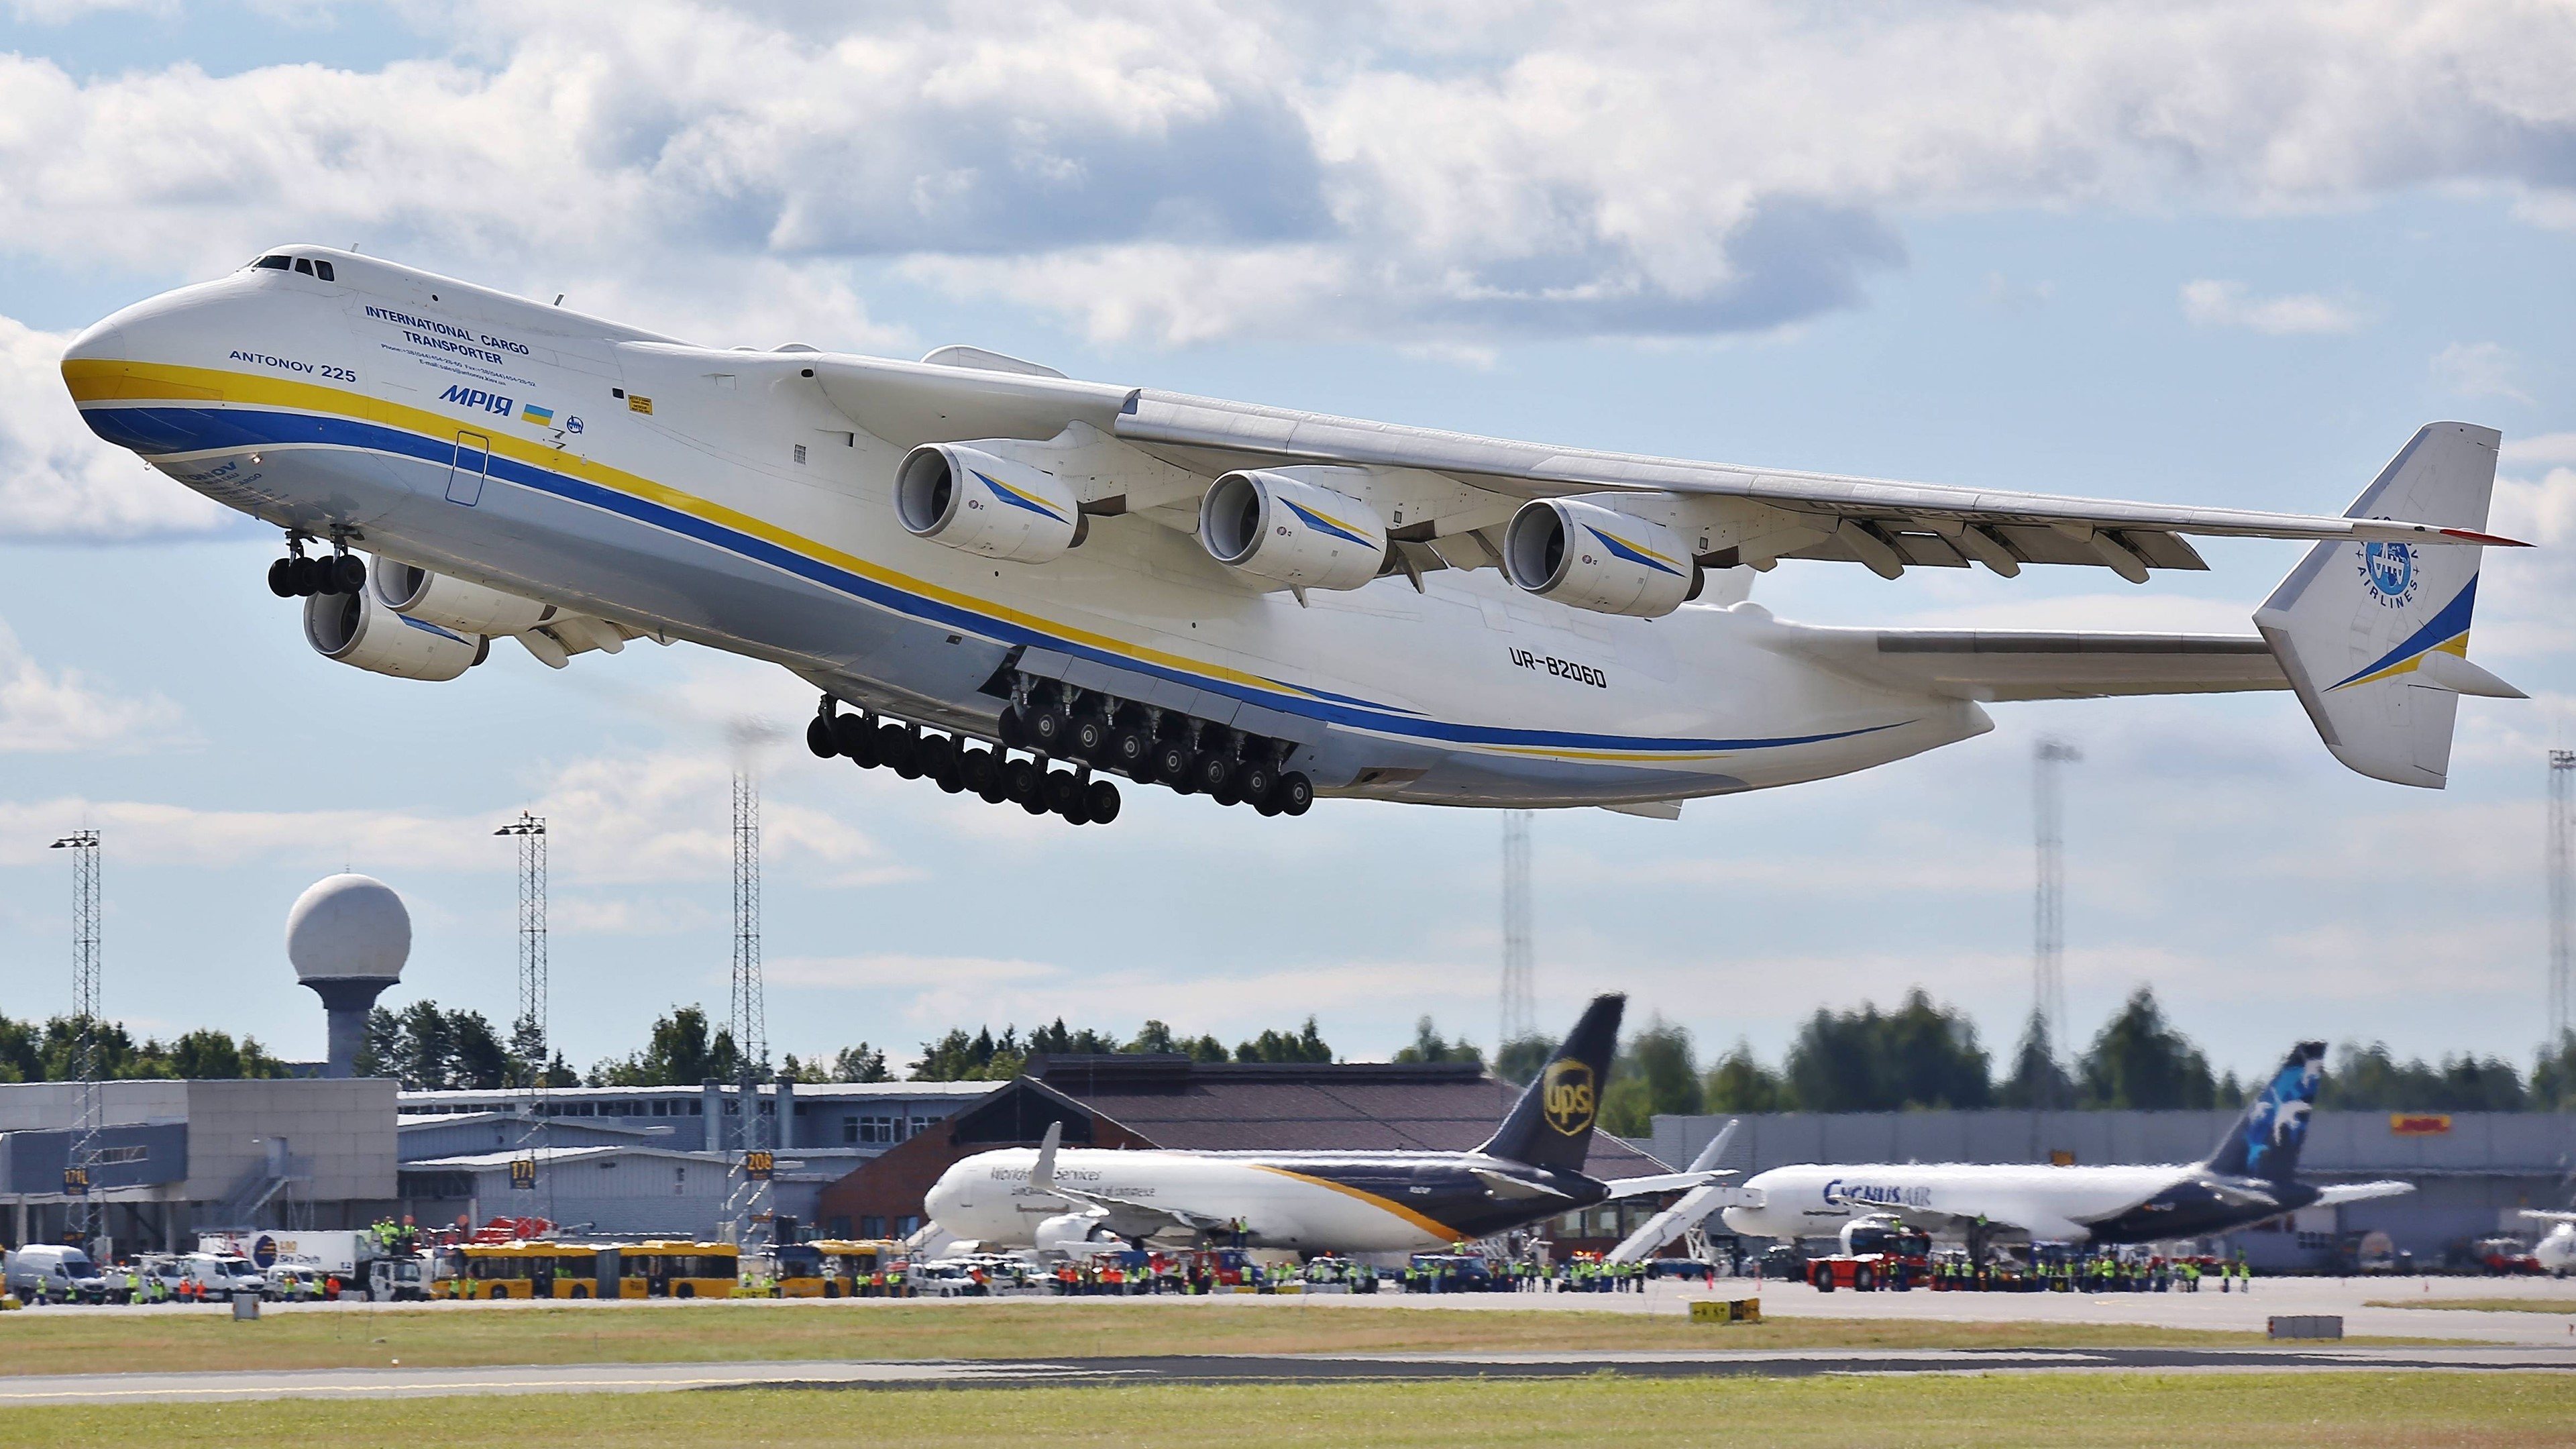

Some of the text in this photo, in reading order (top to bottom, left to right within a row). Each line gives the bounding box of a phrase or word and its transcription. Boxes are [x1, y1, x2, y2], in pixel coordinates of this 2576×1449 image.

[365, 305, 529, 356] INTERNATIONAL CARGO
[402, 330, 503, 365] TRANSPORTER
[229, 350, 357, 382] ANTONOV 225
[2357, 566, 2418, 609] AIRLINES
[1509, 646, 1607, 689] UR-82060
[64, 1169, 89, 1185] 171L
[511, 1161, 534, 1179] 171
[1902, 1186, 1931, 1205] AIR
